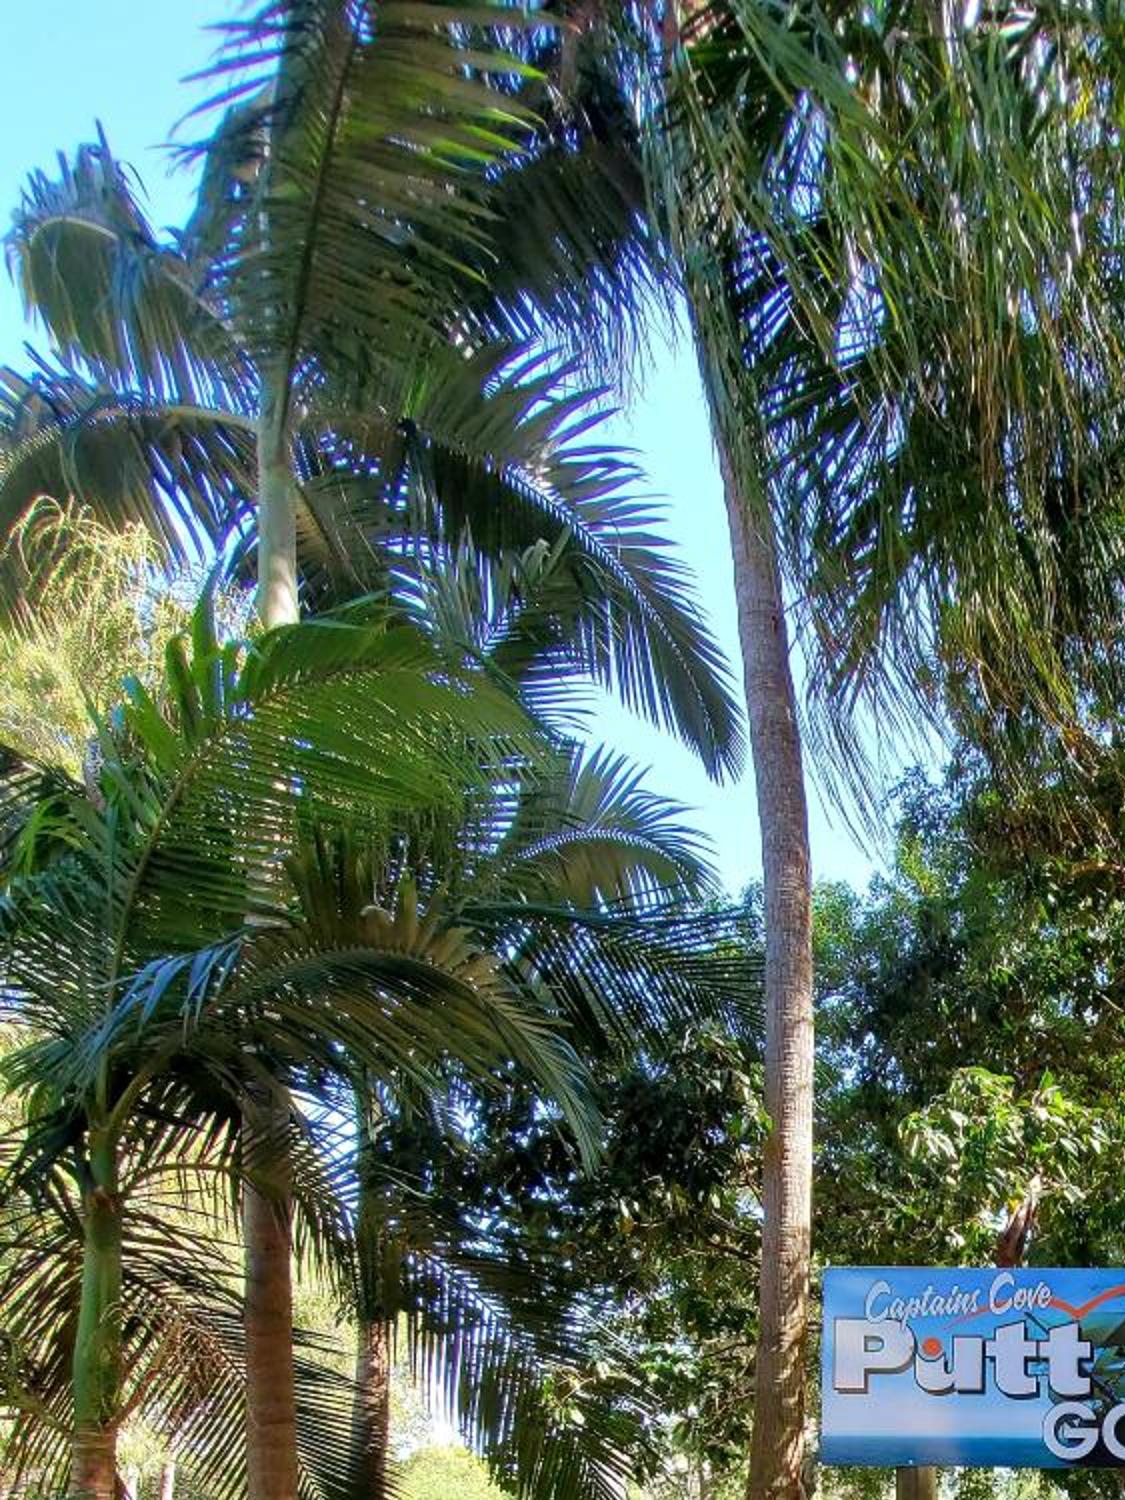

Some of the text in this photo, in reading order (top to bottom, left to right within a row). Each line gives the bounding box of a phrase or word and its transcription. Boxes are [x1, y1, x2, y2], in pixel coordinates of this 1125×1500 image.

[864, 1271, 1052, 1329] Captains Cove
[834, 1317, 1093, 1397] Putt
